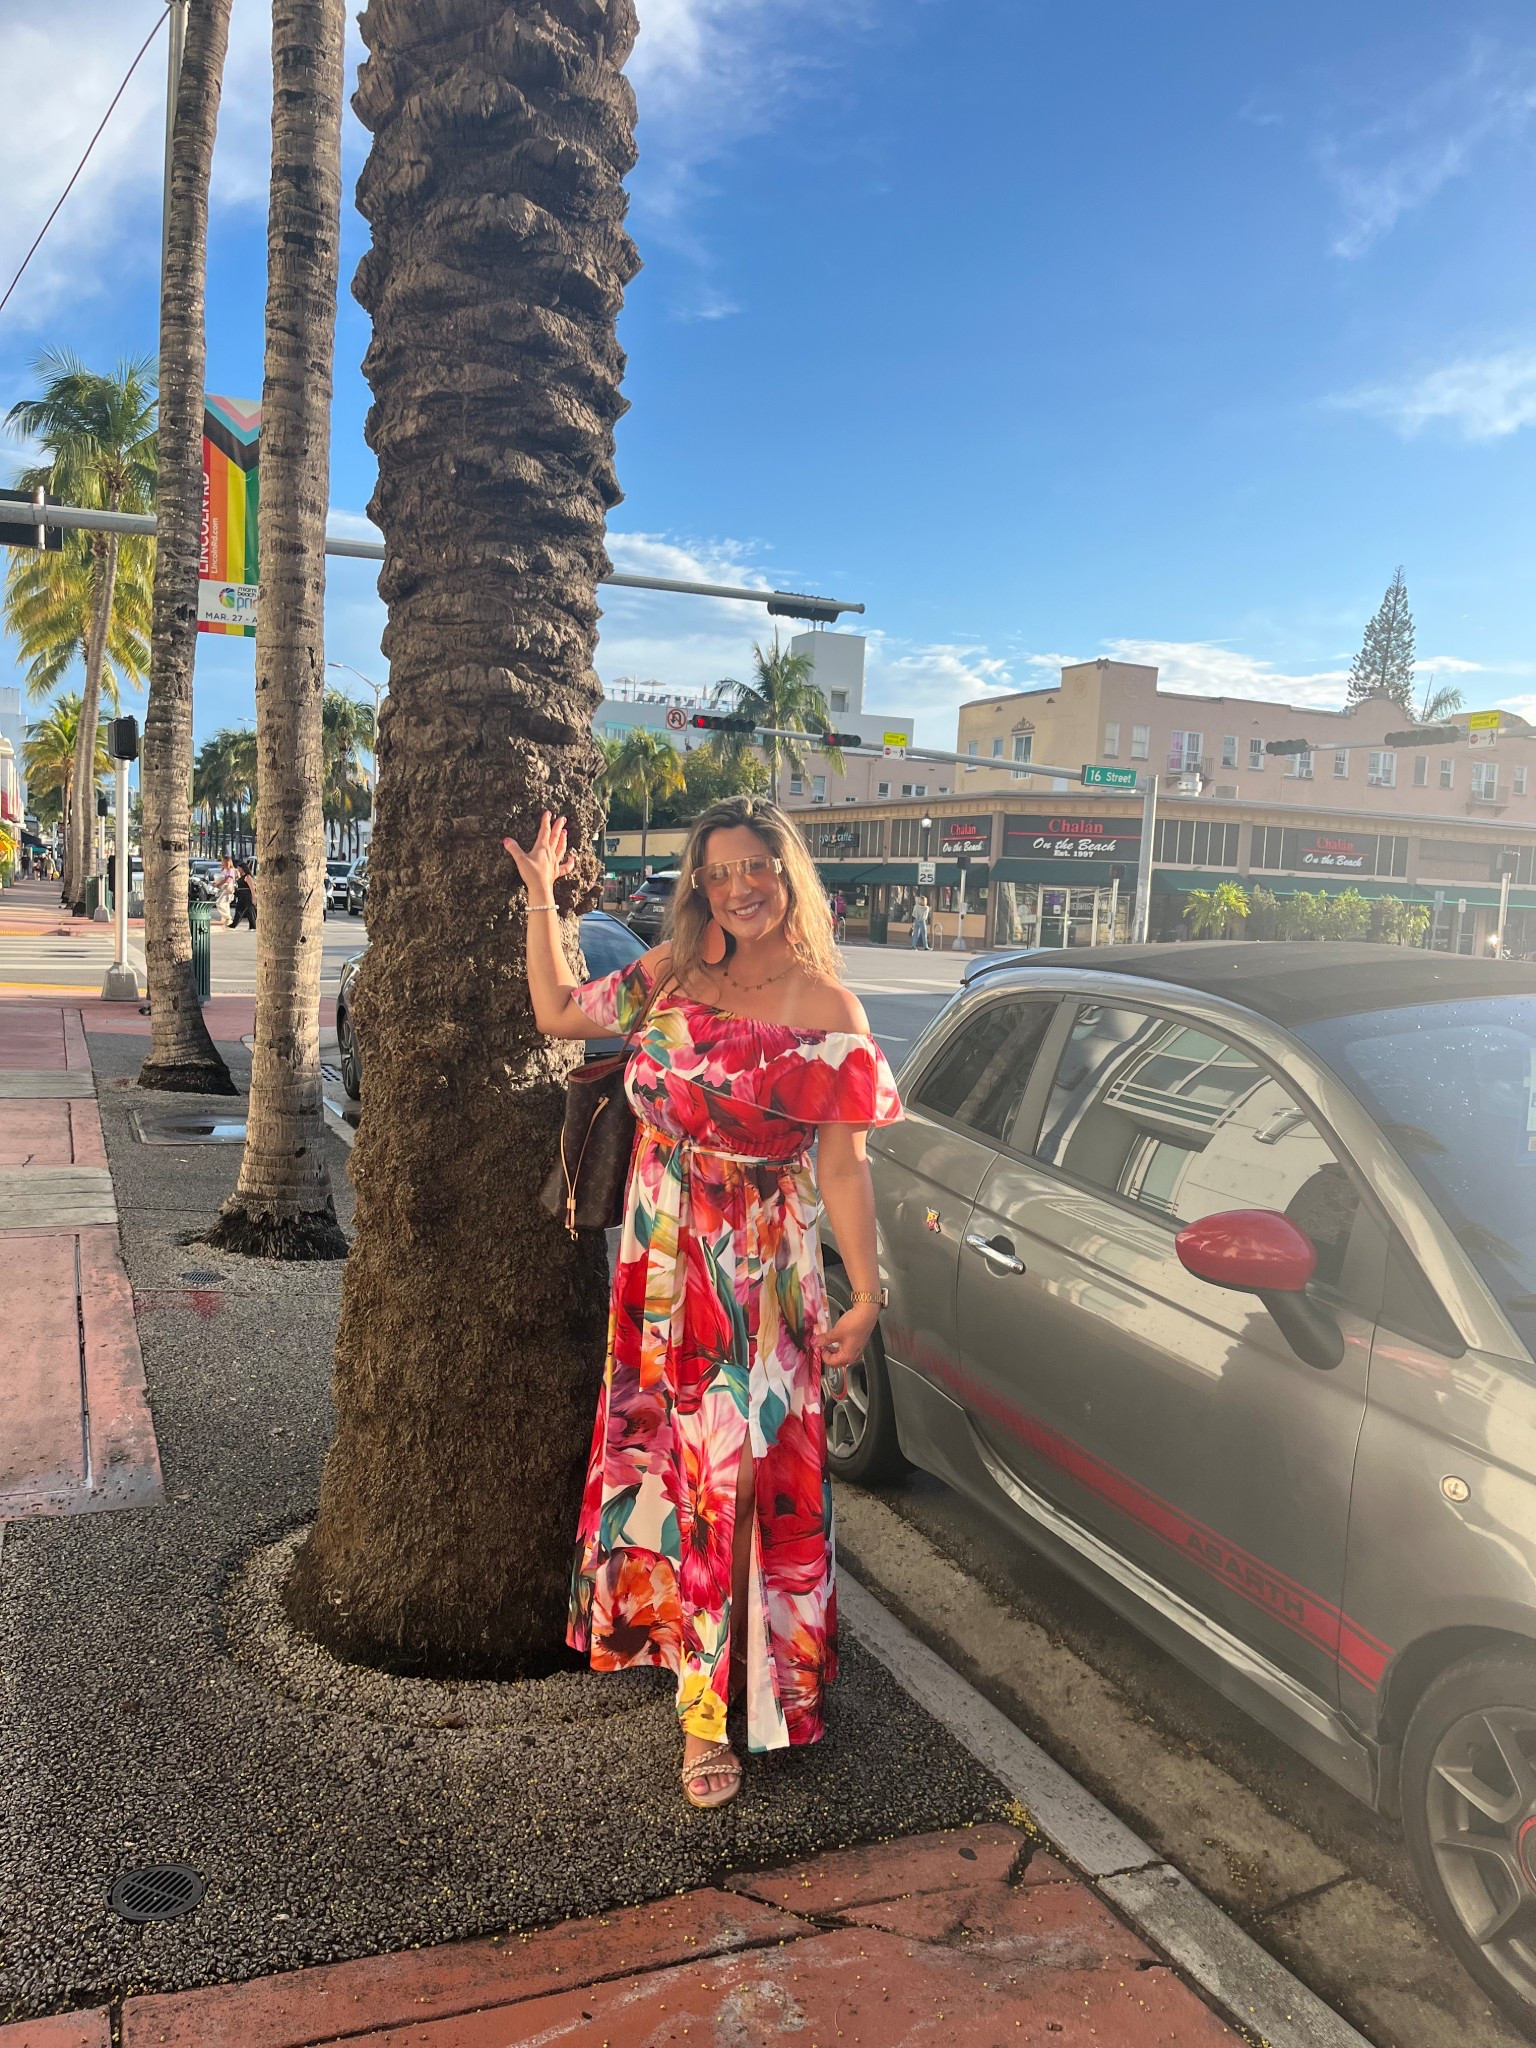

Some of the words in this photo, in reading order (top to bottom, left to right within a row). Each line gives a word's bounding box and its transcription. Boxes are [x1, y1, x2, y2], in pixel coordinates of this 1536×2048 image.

[199, 500, 210, 573] LINCOLN
[211, 517, 219, 574] LincolnRd.com
[237, 586, 257, 594] miami
[205, 612, 230, 621] MAR.
[232, 614, 243, 622] 27
[1090, 770, 1102, 782] 16
[1106, 772, 1131, 783] Street
[1048, 819, 1103, 833] Chalán
[942, 842, 952, 853] On
[952, 841, 963, 853] the
[963, 840, 984, 852] Beach
[1032, 837, 1052, 849] On
[1055, 837, 1074, 850] the
[1078, 838, 1117, 852] Beach
[1053, 849, 1071, 857] Est.
[1073, 850, 1095, 858] 1997
[1303, 853, 1319, 864] On
[1321, 854, 1334, 865] the
[1336, 855, 1363, 867] Beach
[919, 873, 934, 883] 25
[1187, 1531, 1304, 1623] ABARTH
